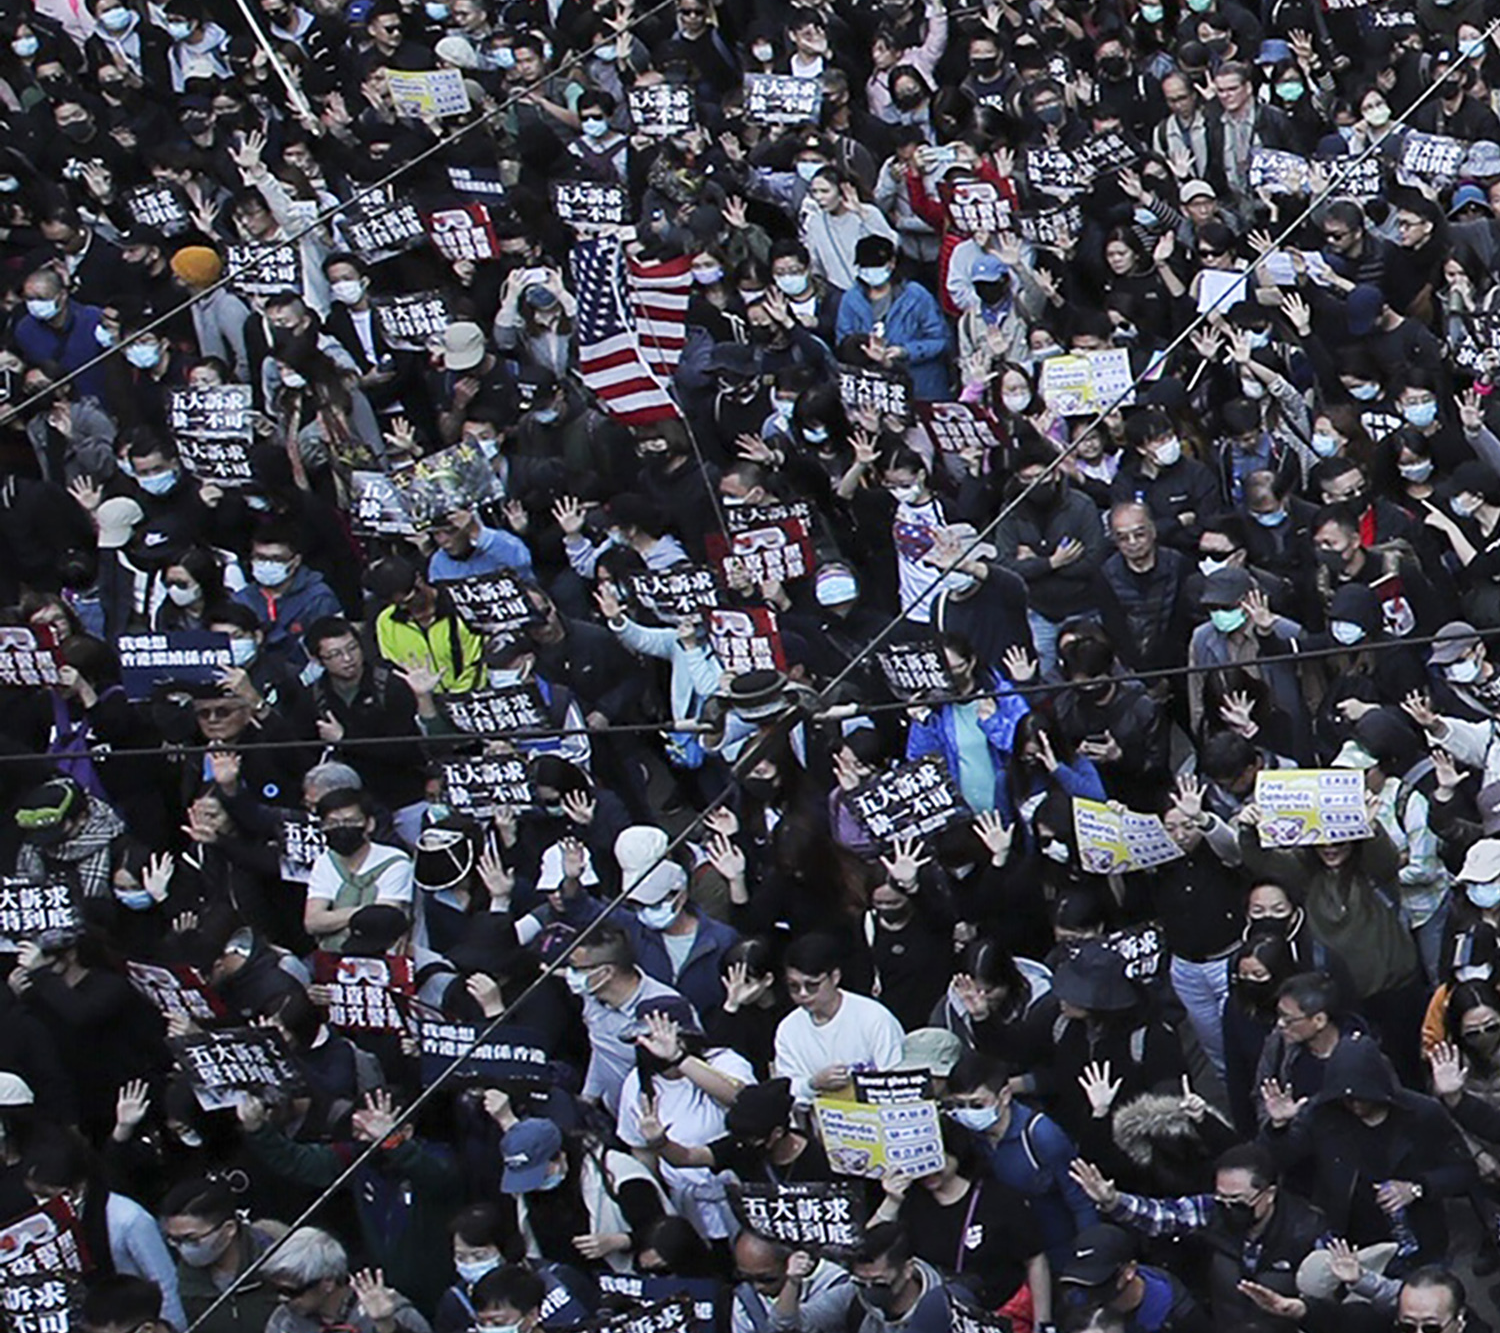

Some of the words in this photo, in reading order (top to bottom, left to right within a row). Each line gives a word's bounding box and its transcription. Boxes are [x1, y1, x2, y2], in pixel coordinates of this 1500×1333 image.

[741, 1196, 851, 1223] 五大訴求
[741, 1219, 854, 1248] 堅持到底
